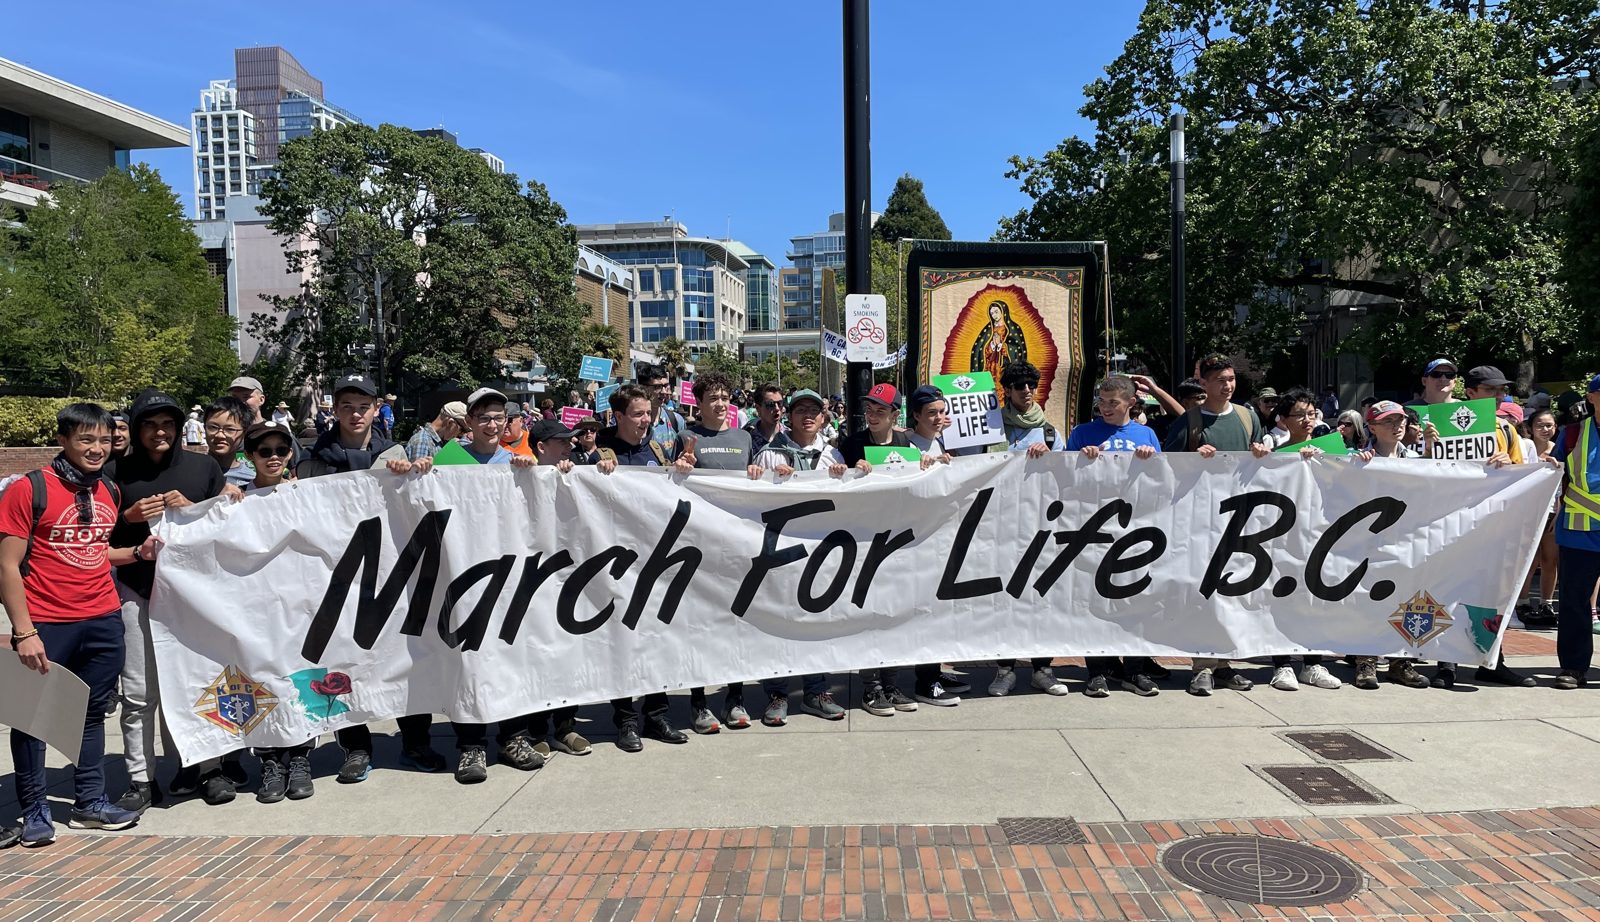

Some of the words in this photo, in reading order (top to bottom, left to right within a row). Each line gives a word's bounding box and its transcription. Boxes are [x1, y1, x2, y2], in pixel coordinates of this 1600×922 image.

[824, 332, 837, 344] THE
[831, 348, 842, 358] BC
[874, 386, 884, 395] B
[945, 393, 998, 415] DEFEND
[957, 415, 989, 438] LIFE
[1433, 436, 1495, 460] DEFEND
[300, 499, 703, 665] March
[731, 499, 915, 617] For
[936, 487, 1168, 600] Life
[1199, 490, 1407, 601] B.C.
[1405, 603, 1413, 611] K
[1428, 605, 1435, 613] C
[217, 684, 227, 695] K
[245, 684, 252, 693] C
